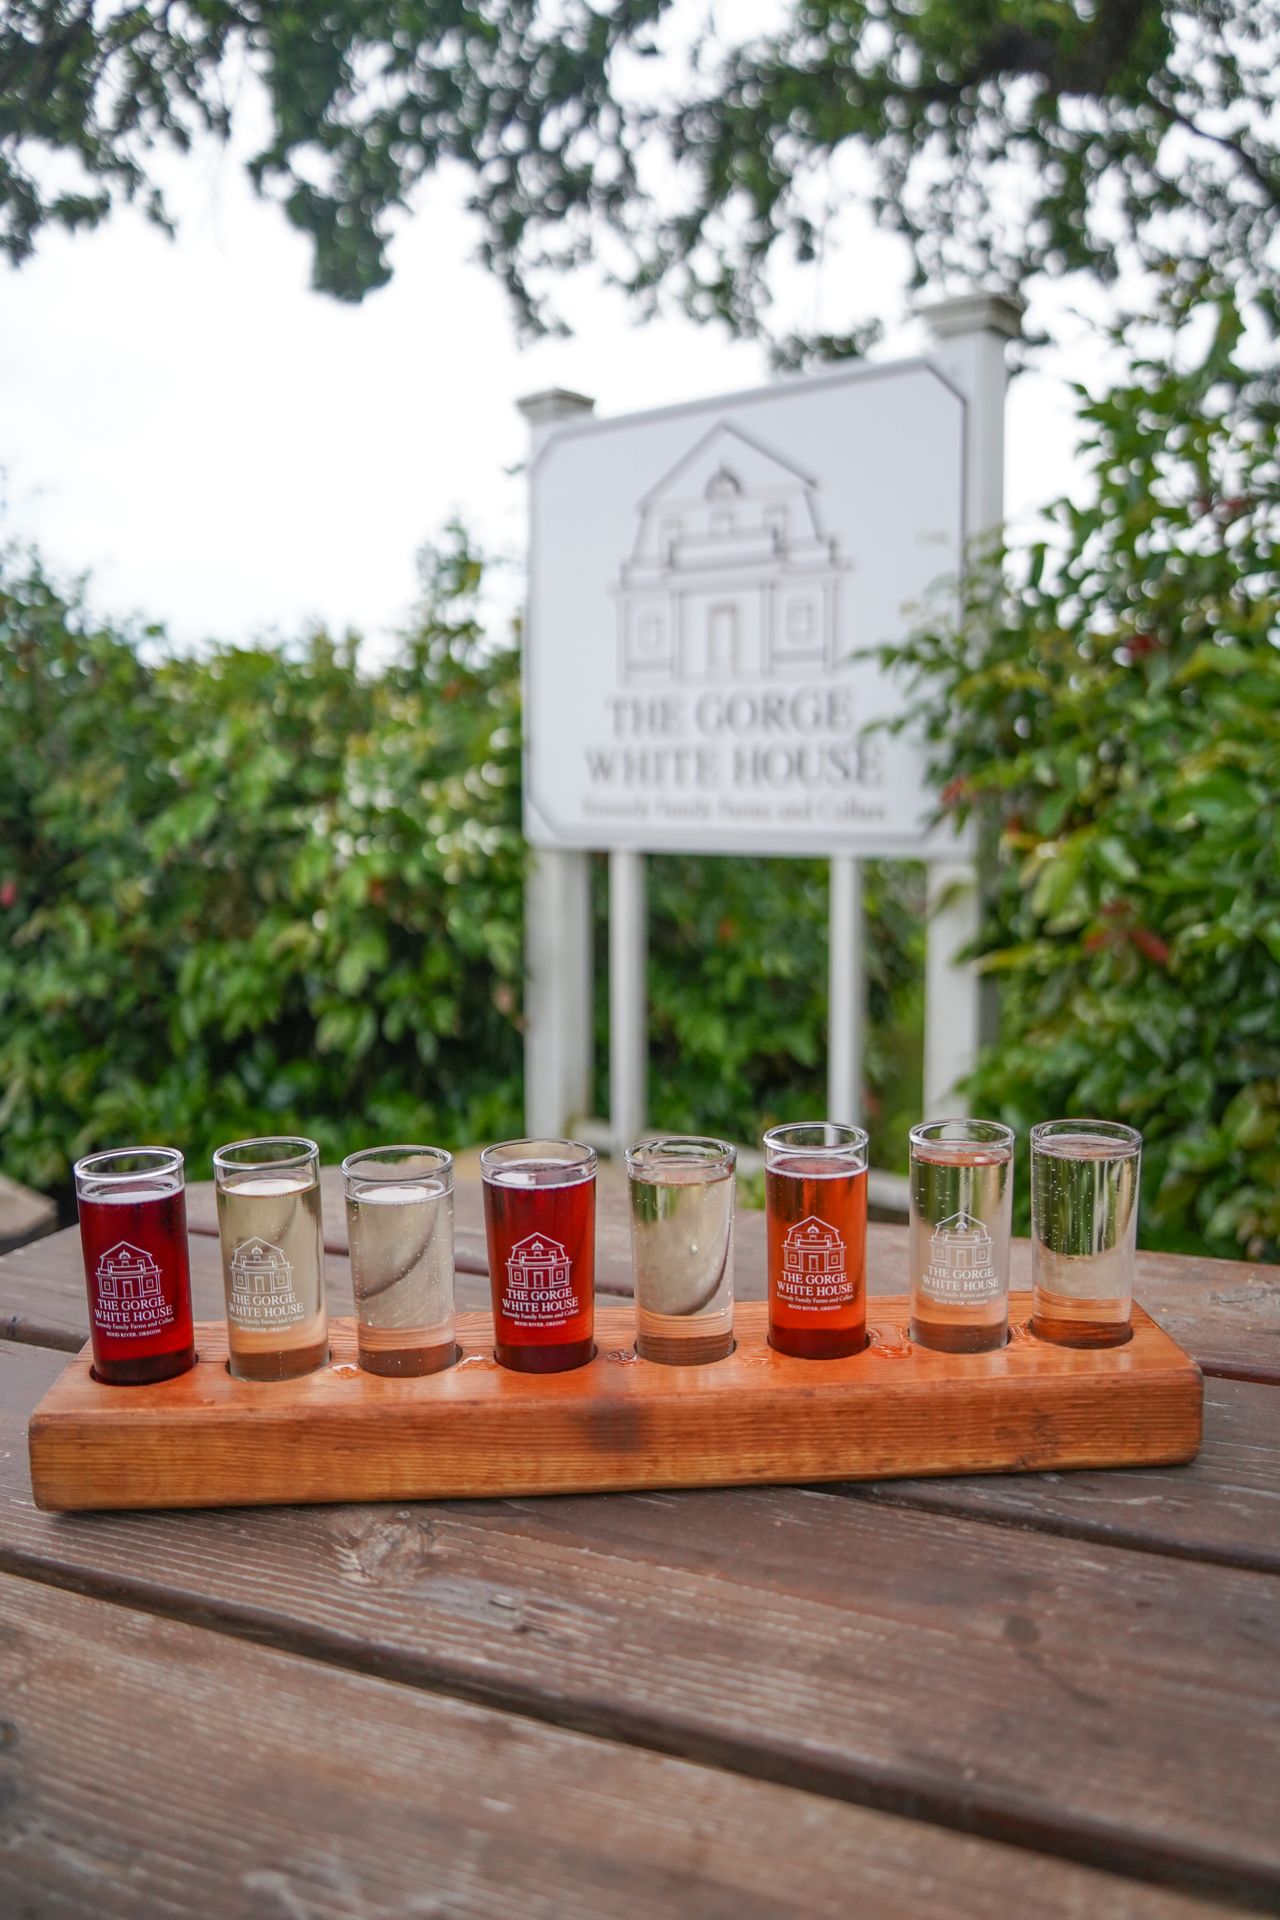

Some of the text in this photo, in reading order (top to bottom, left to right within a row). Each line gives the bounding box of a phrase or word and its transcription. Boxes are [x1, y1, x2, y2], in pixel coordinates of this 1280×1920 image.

[607, 686, 854, 738] THE GORGE
[584, 741, 886, 790] WHITE HOUSE
[781, 1271, 847, 1284] THE GORGE
[928, 1265, 994, 1279] THE GORGE
[777, 1280, 853, 1296] WHITE HOUSE
[923, 1274, 999, 1290] WHITE HOUSE
[232, 1292, 296, 1306] THE GORGE
[506, 1287, 572, 1301] THE GORGE
[98, 1296, 165, 1311] THE GORGE
[228, 1303, 304, 1317] WHITE HOUSE
[502, 1297, 578, 1312] WHITE HOUSE
[95, 1305, 173, 1322] WHITE HOUSE
